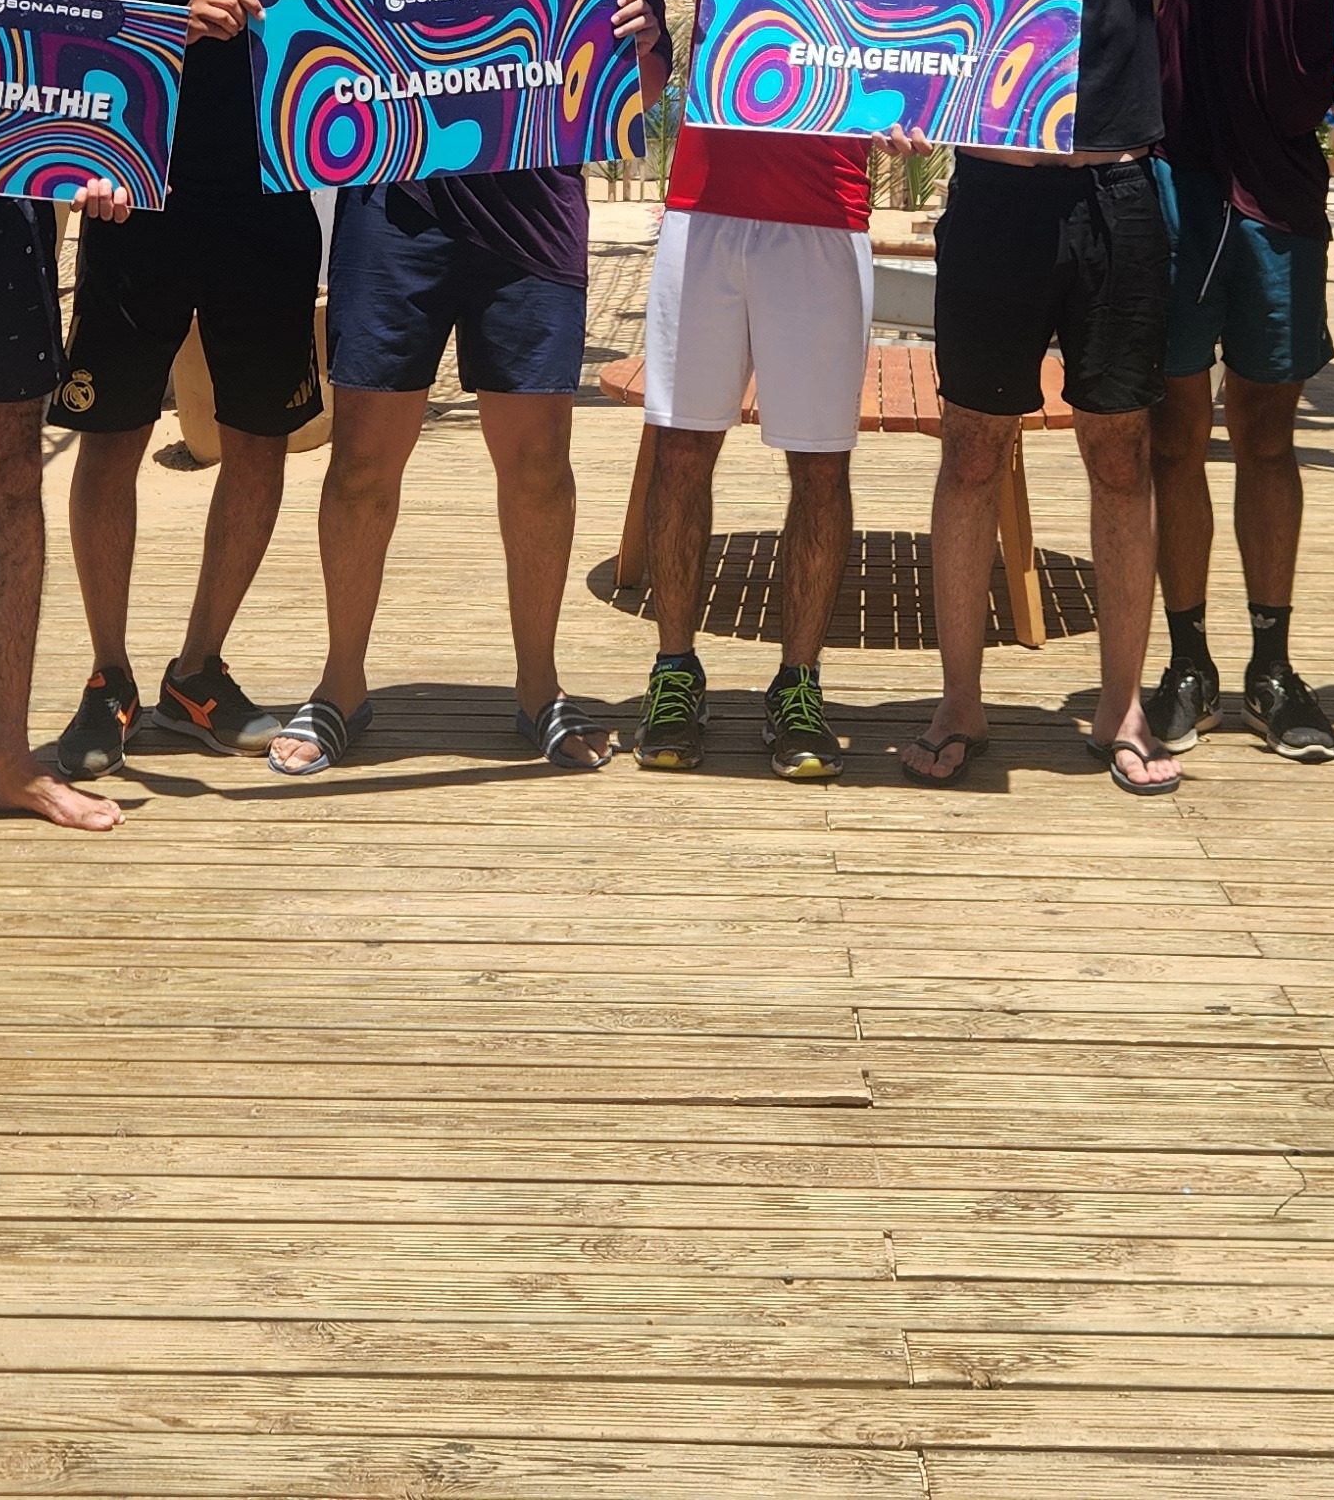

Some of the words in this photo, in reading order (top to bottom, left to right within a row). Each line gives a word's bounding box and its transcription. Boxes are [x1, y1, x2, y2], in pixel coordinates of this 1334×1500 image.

[6, 0, 104, 19] SONARGES
[787, 41, 978, 78] ENGAGEMENT
[334, 59, 563, 104] COLLABORATION
